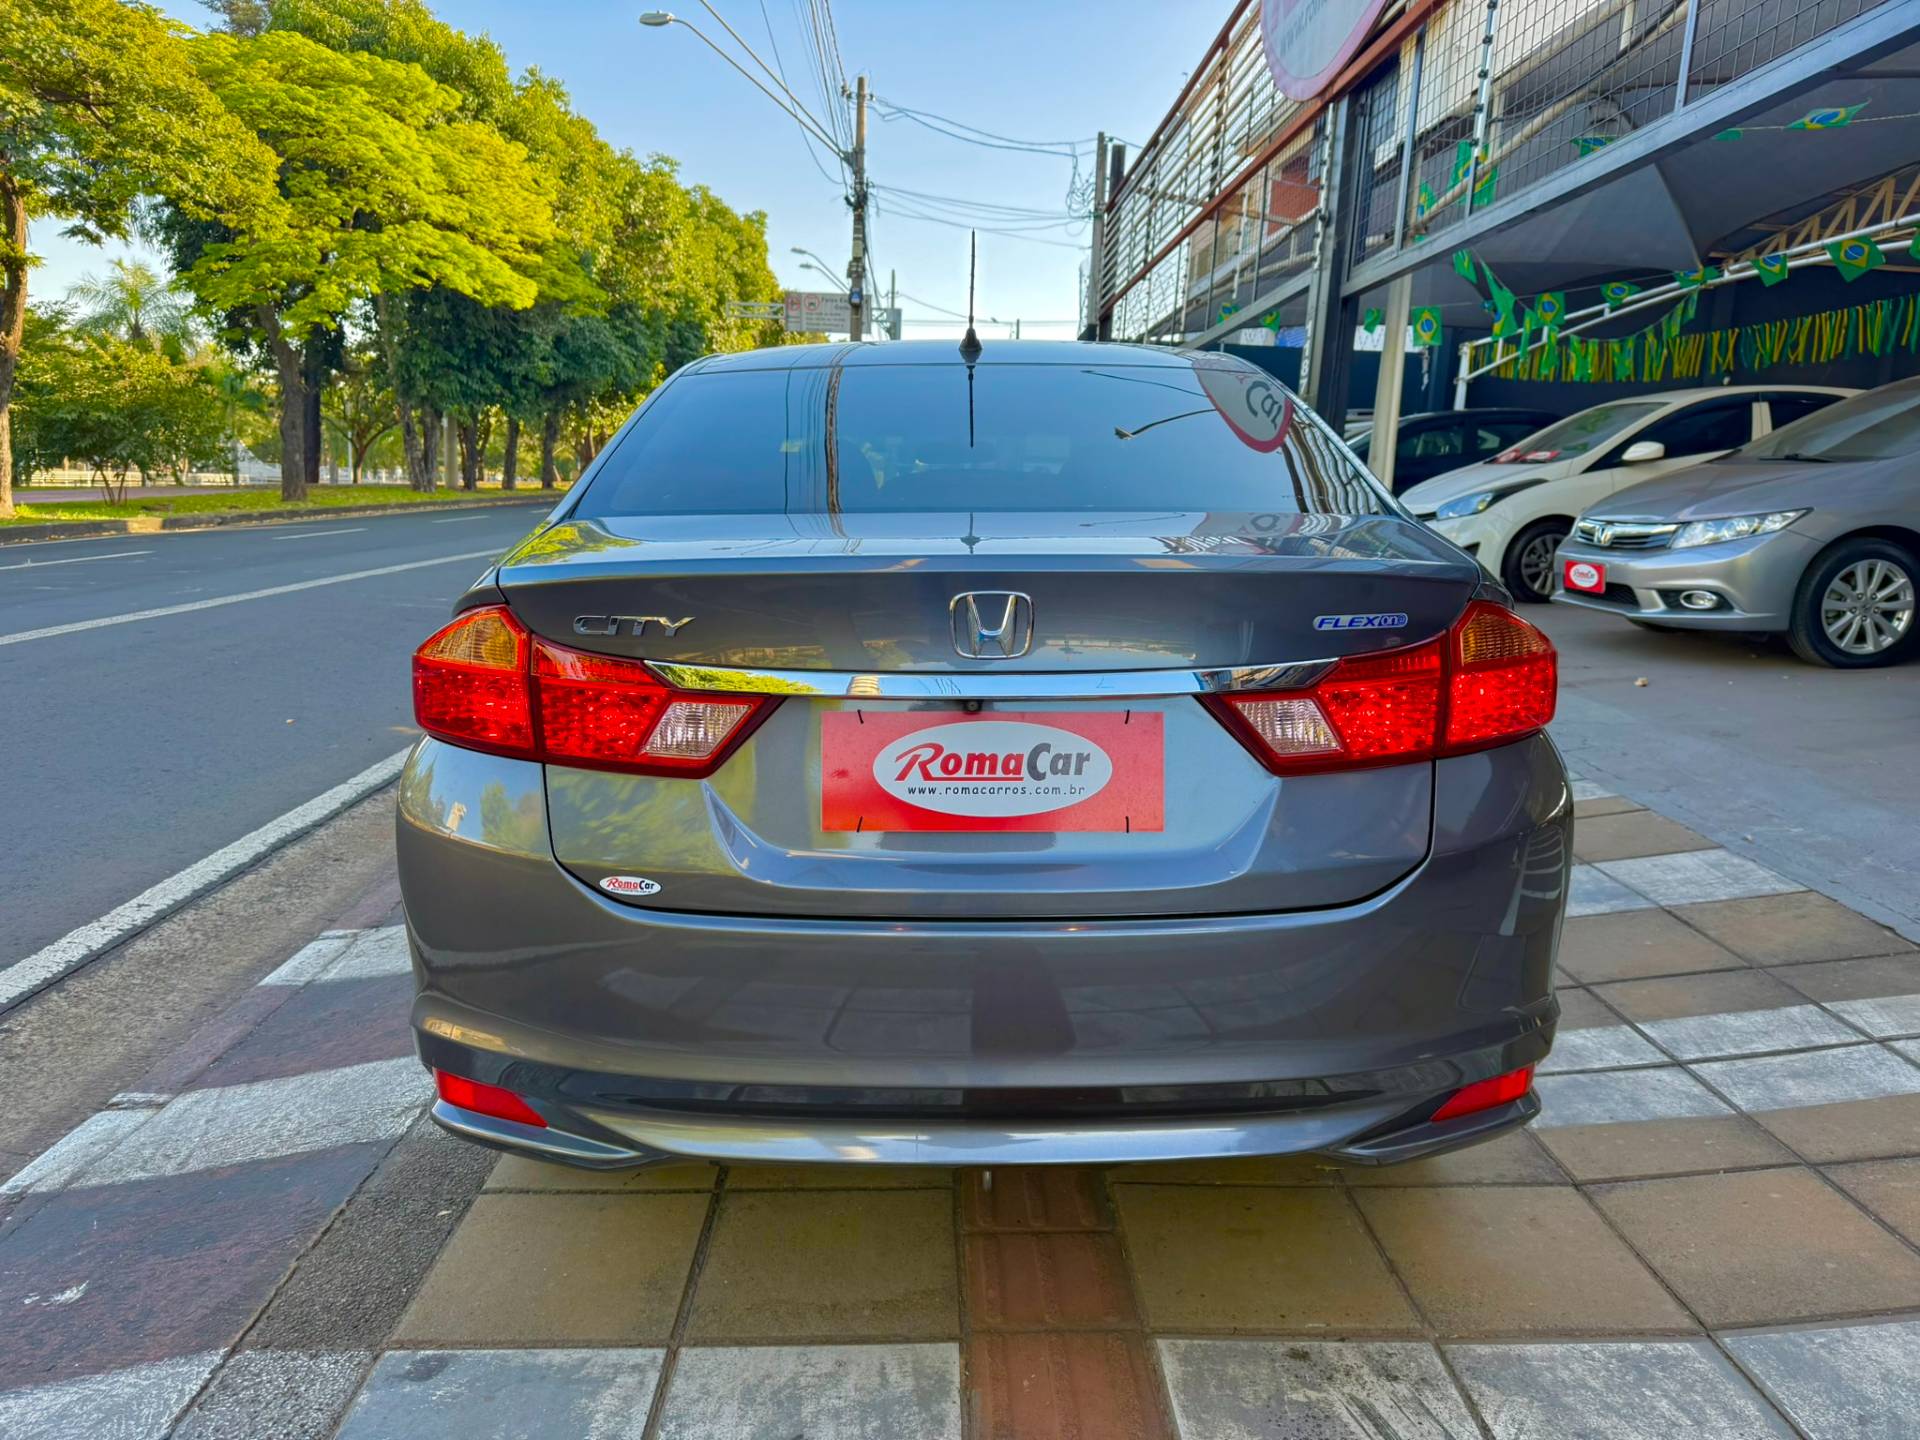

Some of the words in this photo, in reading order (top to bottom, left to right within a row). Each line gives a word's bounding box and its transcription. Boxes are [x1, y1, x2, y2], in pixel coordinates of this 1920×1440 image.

[573, 615, 697, 637] CITY
[895, 742, 1091, 782] RomaCar
[907, 784, 1086, 796] www.romacarros.com.br
[606, 877, 655, 891] RomaCar
